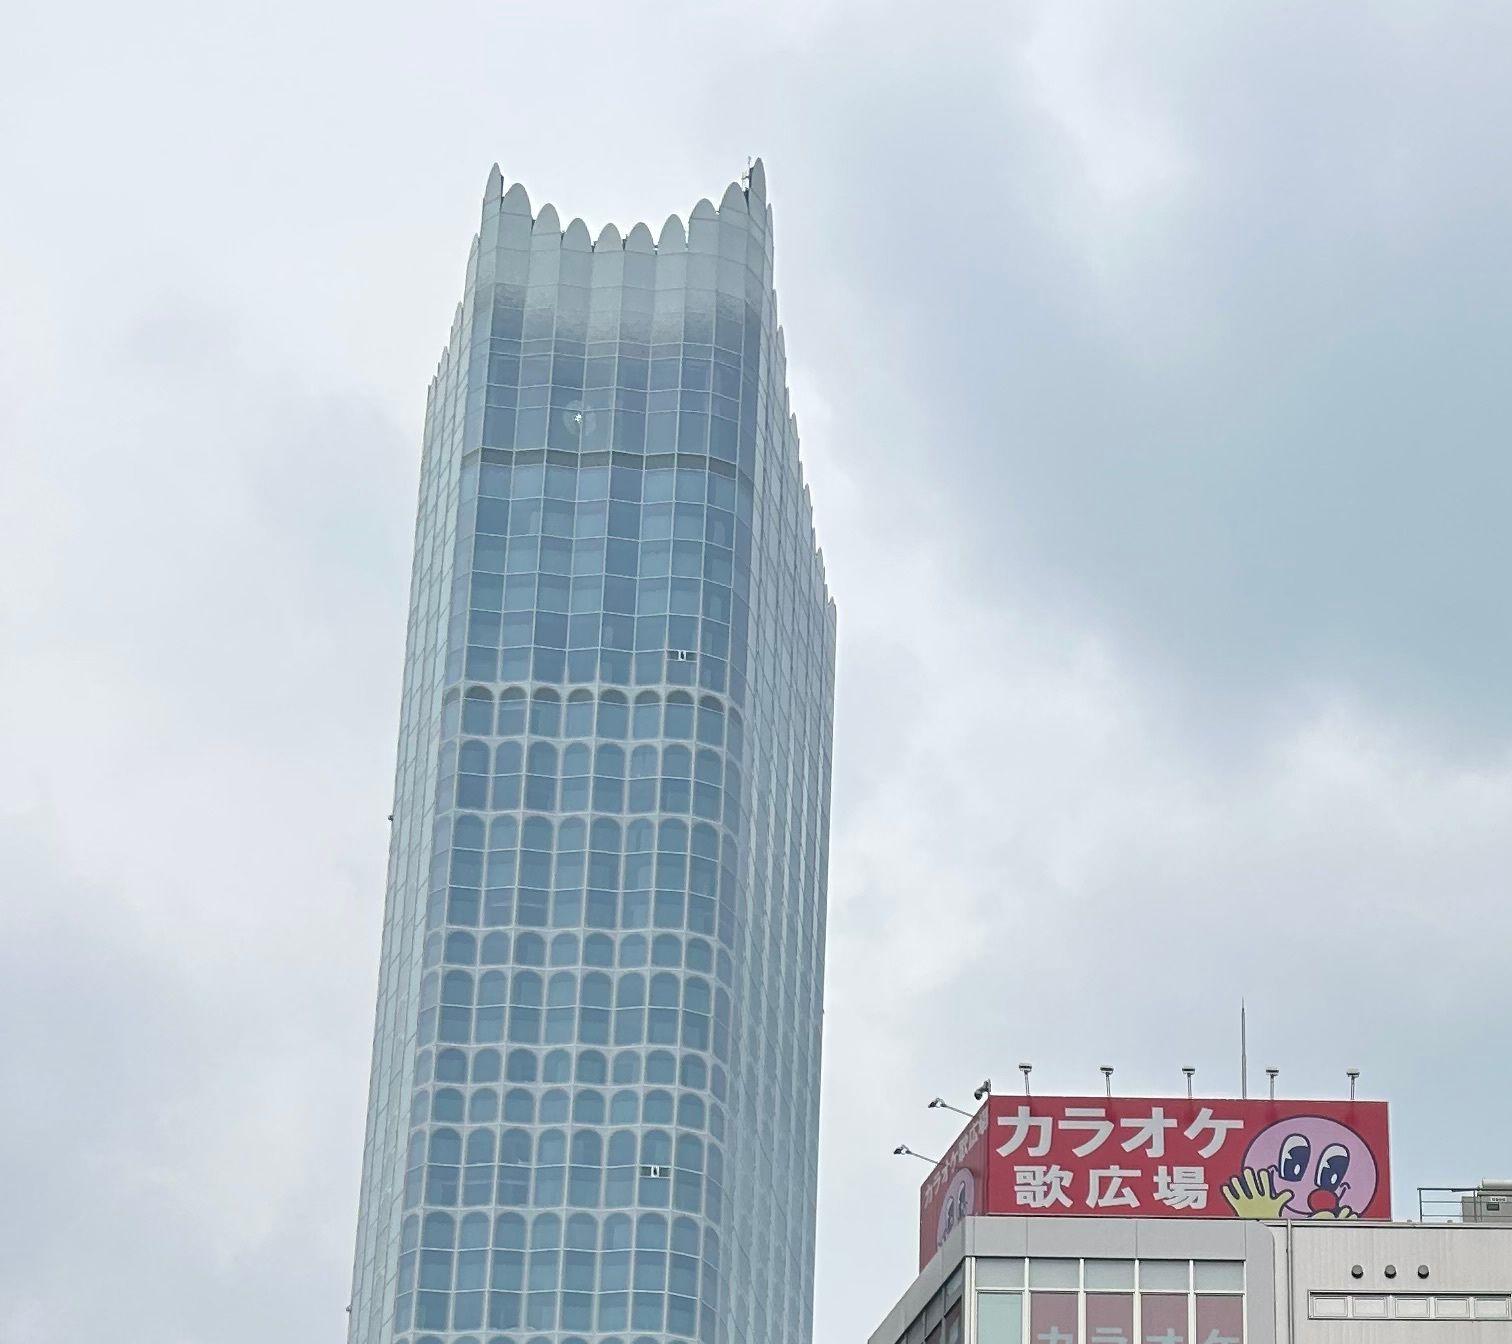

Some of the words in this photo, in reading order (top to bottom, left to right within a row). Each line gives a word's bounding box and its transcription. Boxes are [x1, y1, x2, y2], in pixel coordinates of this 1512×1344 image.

[997, 1105, 1245, 1158] カラオケ
[1014, 1165, 1209, 1210] 歌広場
